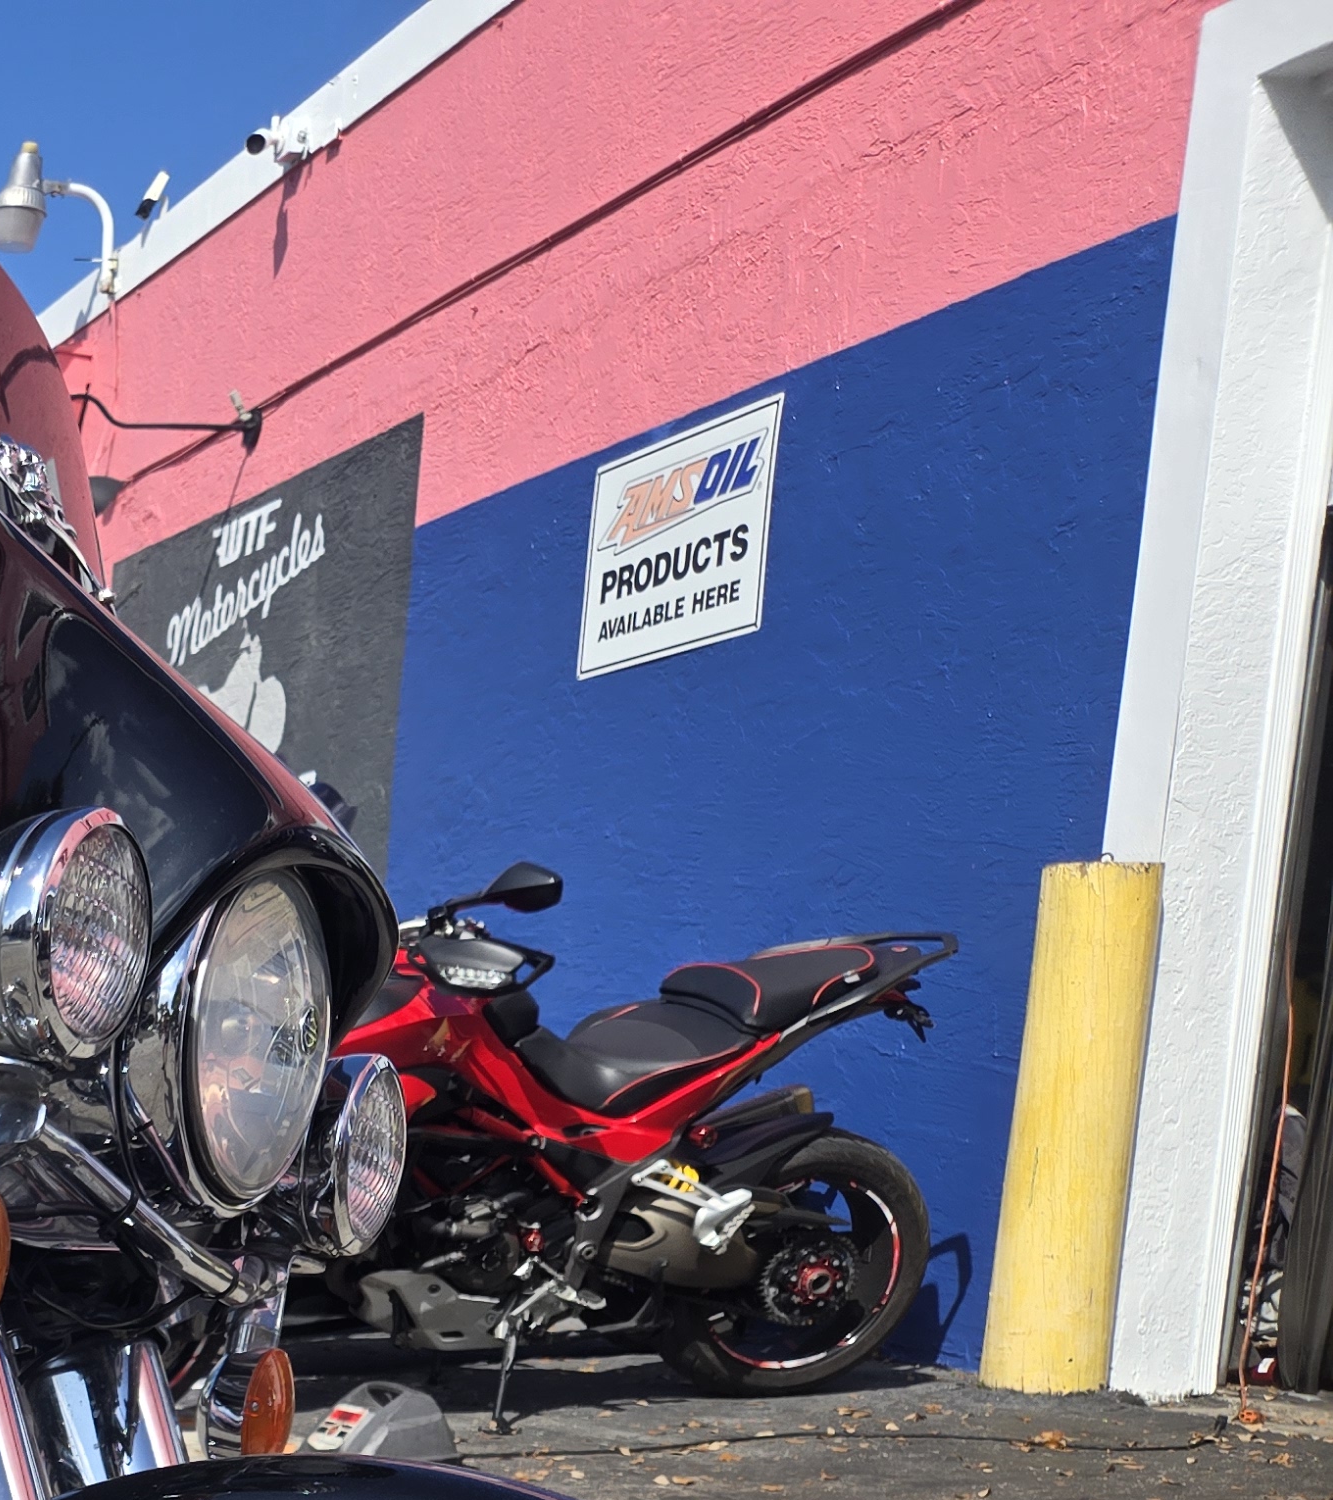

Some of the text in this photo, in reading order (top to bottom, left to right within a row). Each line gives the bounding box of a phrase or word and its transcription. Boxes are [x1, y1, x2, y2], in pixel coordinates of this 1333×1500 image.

[212, 497, 282, 568] WTF
[606, 436, 761, 547] AMSOIL
[166, 512, 326, 667] Motorcycles
[600, 523, 749, 605] PRODUCTS
[598, 579, 742, 643] AVAILABLE HERE
